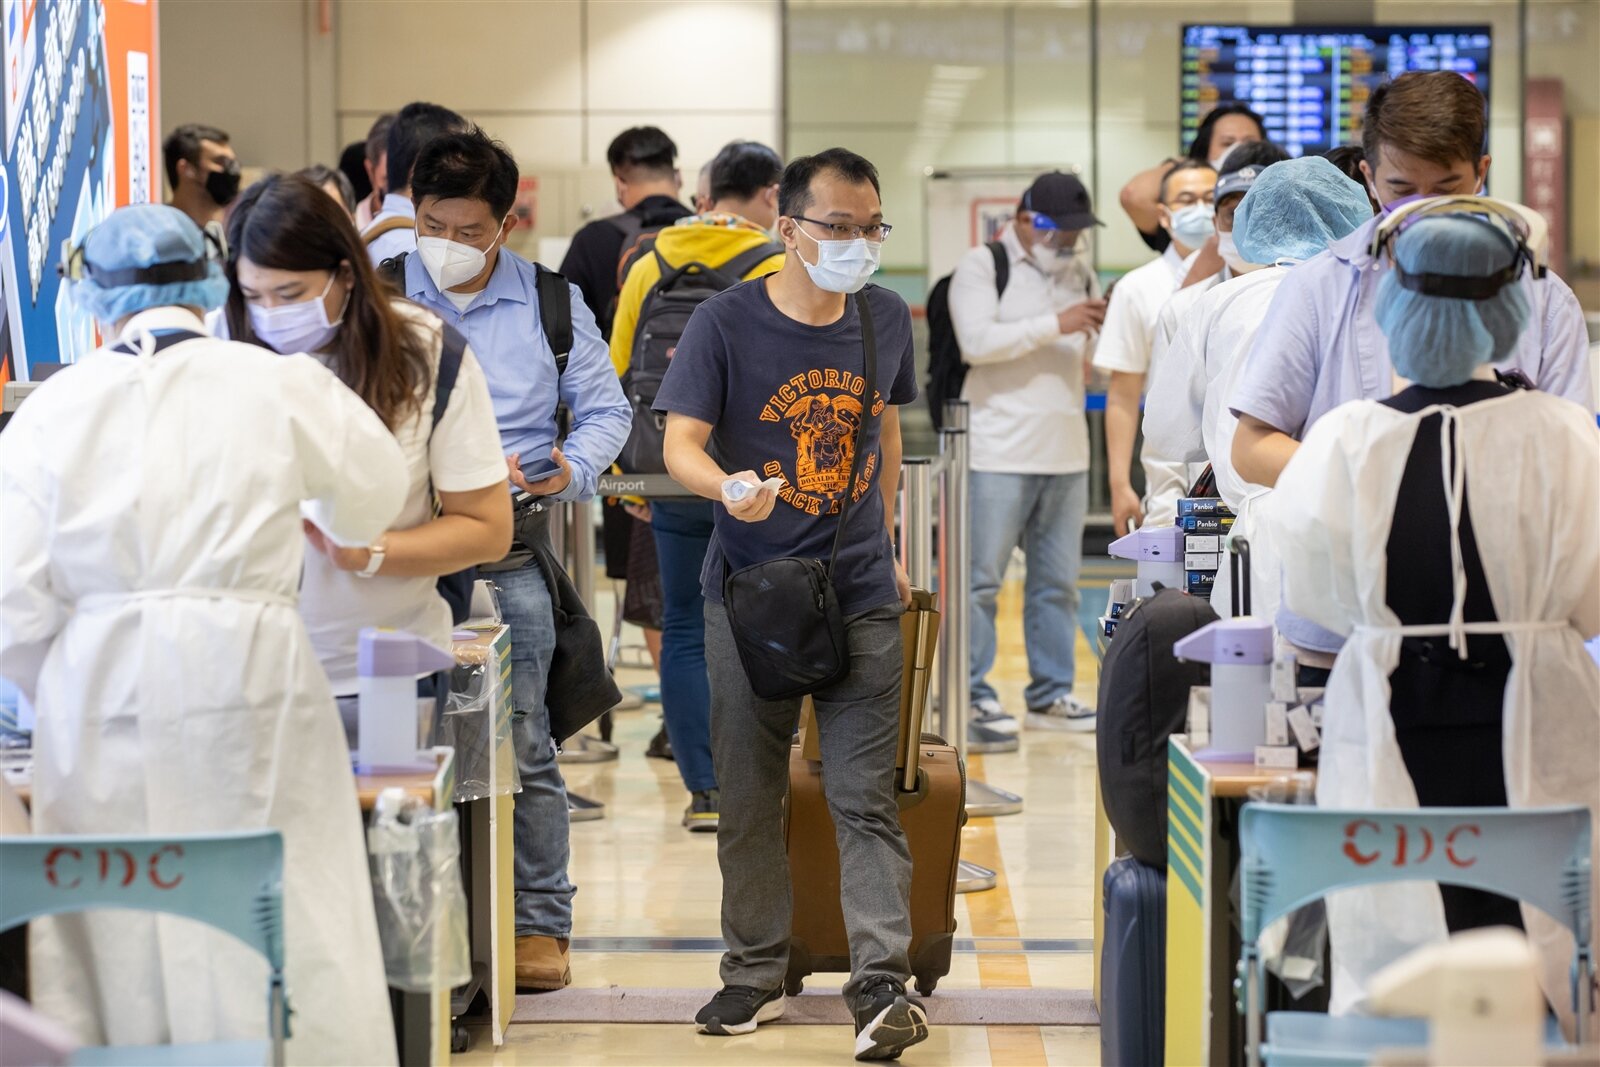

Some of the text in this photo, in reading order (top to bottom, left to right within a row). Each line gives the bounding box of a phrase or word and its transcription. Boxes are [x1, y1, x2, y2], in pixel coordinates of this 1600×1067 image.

[759, 368, 886, 423] VICTORIOS
[598, 479, 645, 492] Airport
[801, 475, 835, 485] DONALDS
[825, 452, 876, 515] ATACK
[1193, 502, 1214, 510] Panbio
[1197, 520, 1218, 528] Panbio
[1342, 819, 1482, 867] CDC
[43, 843, 185, 890] CDC
